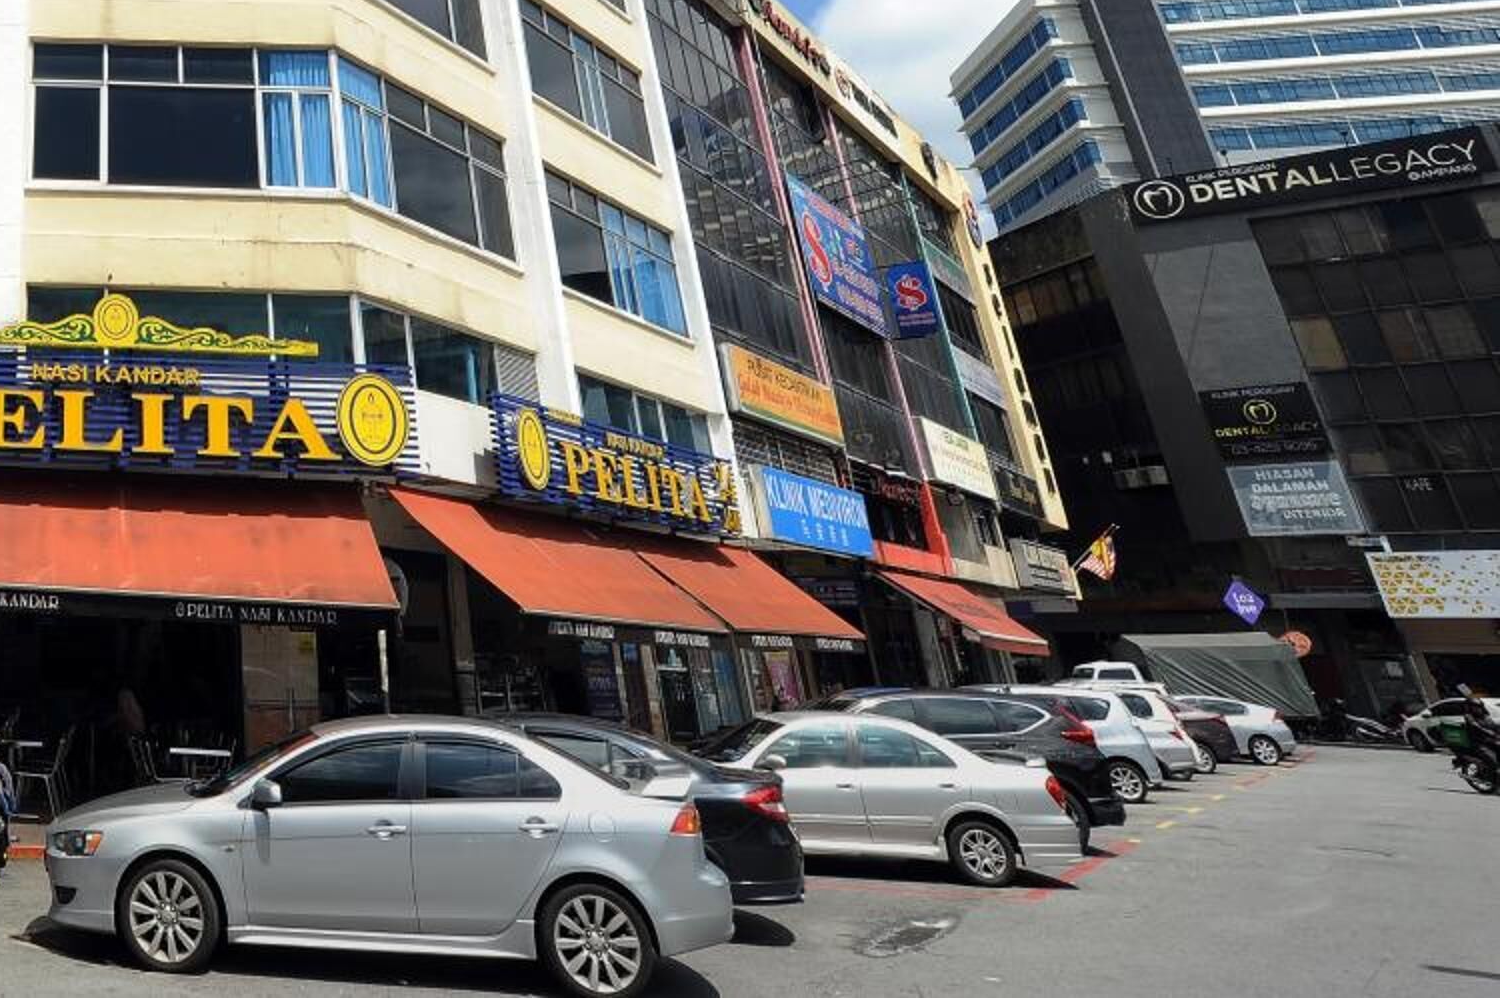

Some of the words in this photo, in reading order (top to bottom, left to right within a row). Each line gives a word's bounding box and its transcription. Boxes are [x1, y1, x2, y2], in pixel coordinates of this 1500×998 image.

[29, 361, 86, 384] NASI
[97, 363, 201, 387] KANDAR
[559, 441, 713, 523] PELITA
[766, 473, 807, 513] KLINIK
[0, 591, 60, 610] KANDAR
[187, 602, 233, 620] PELITA
[240, 605, 271, 622] NASI
[277, 607, 337, 625] KANDAR
